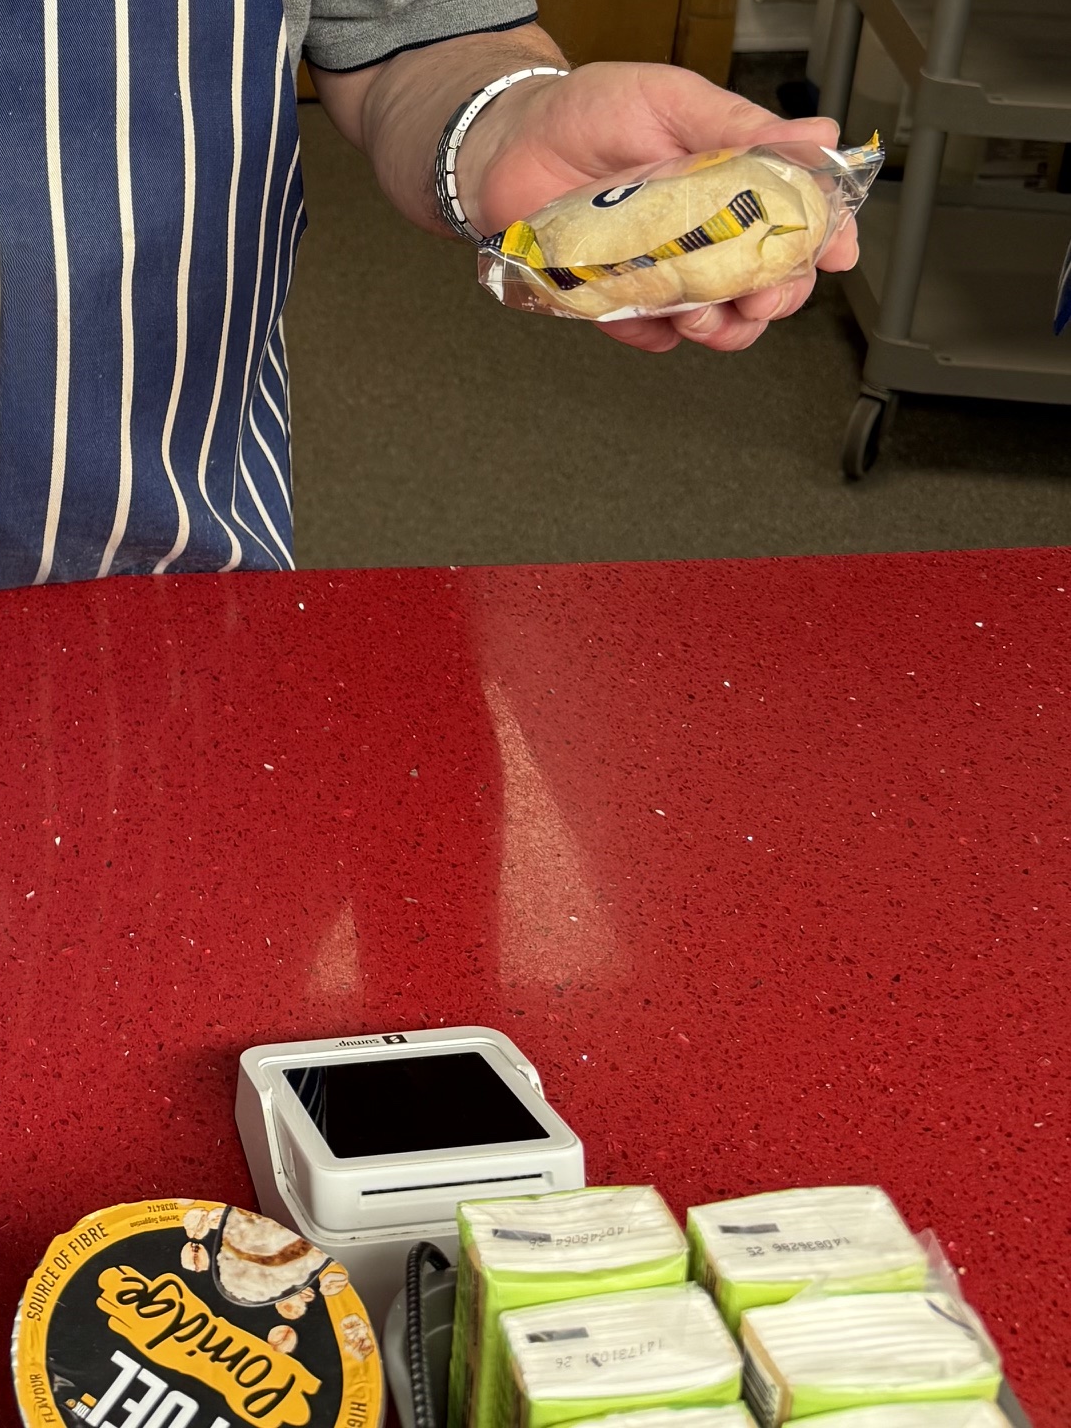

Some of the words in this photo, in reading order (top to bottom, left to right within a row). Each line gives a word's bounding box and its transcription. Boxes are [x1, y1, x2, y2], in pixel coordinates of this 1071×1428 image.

[338, 1038, 380, 1049] sumup
[146, 1201, 180, 1213] 3038414
[158, 1214, 181, 1224] Serving
[26, 1266, 55, 1323] SOURCE
[52, 1249, 72, 1272] OF
[67, 1222, 110, 1254] FIBRE
[114, 1275, 297, 1420] Porridge
[25, 1372, 57, 1424] FLAVOUR
[344, 1401, 368, 1428] HIG
